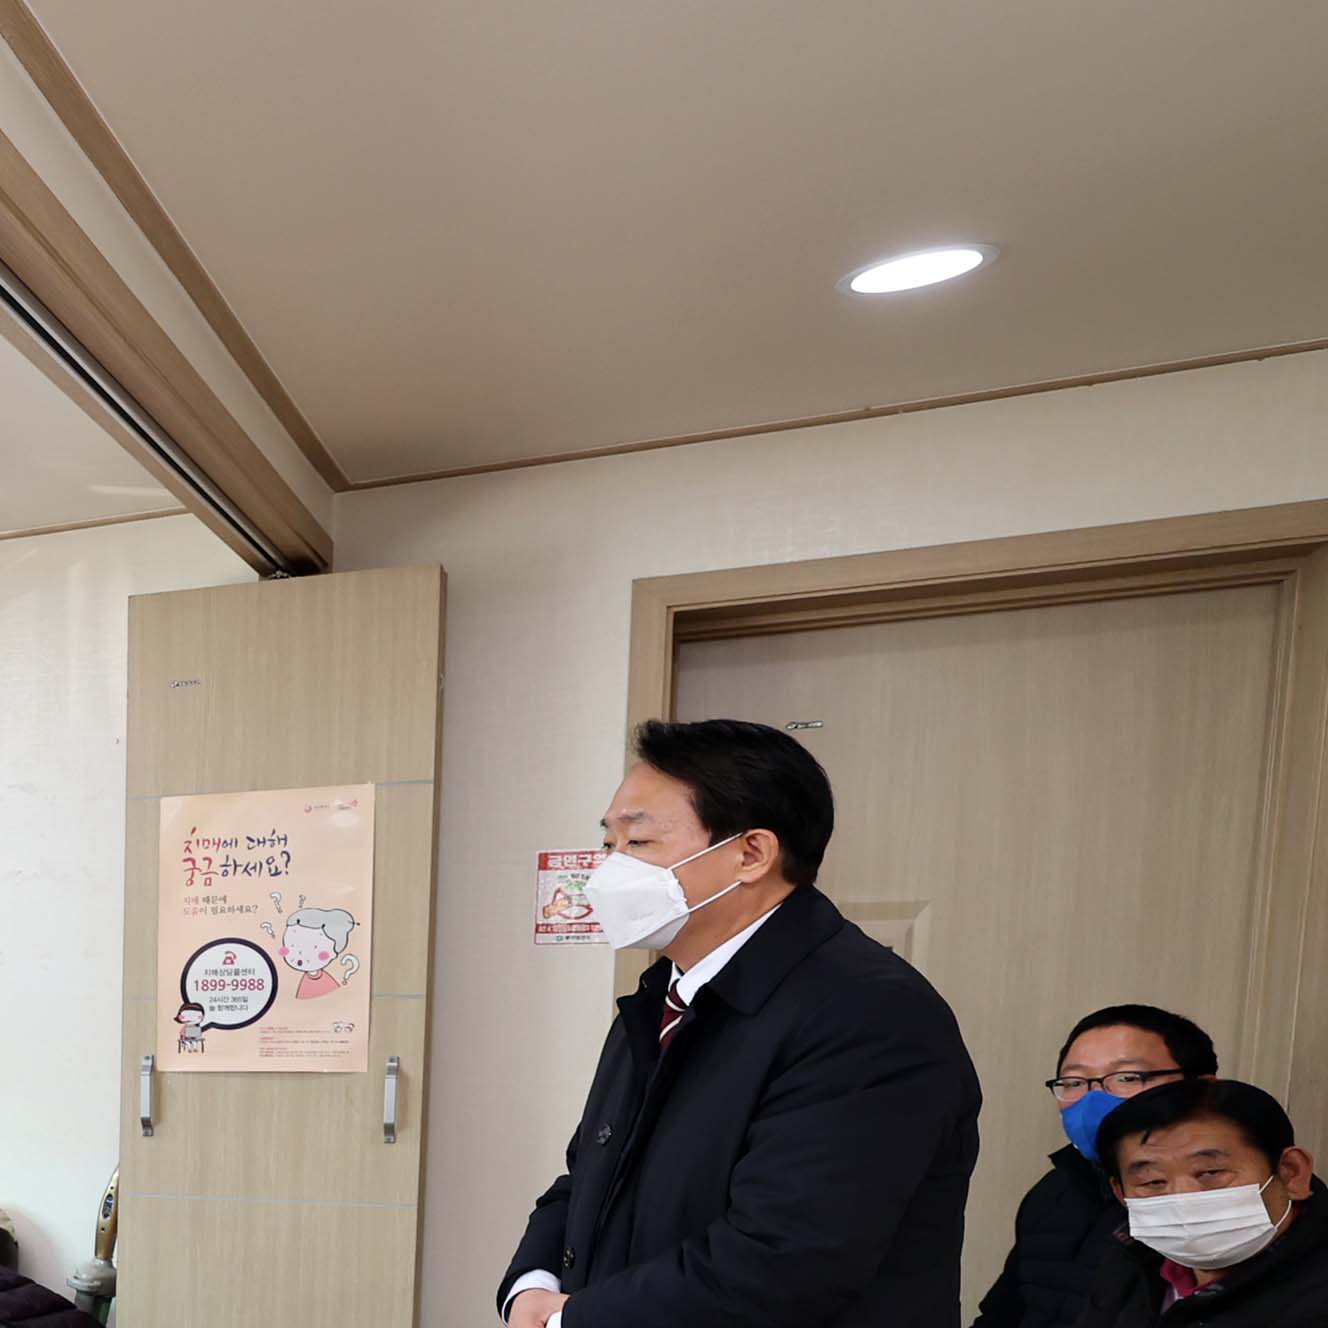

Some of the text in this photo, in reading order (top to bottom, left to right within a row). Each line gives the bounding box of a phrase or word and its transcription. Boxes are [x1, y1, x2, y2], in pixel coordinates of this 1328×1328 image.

[183, 826, 289, 855] 치매에 대해
[182, 850, 292, 888] 궁금하세요?
[203, 967, 256, 977] 치매상담콜센터
[193, 978, 265, 993] 1899-9988
